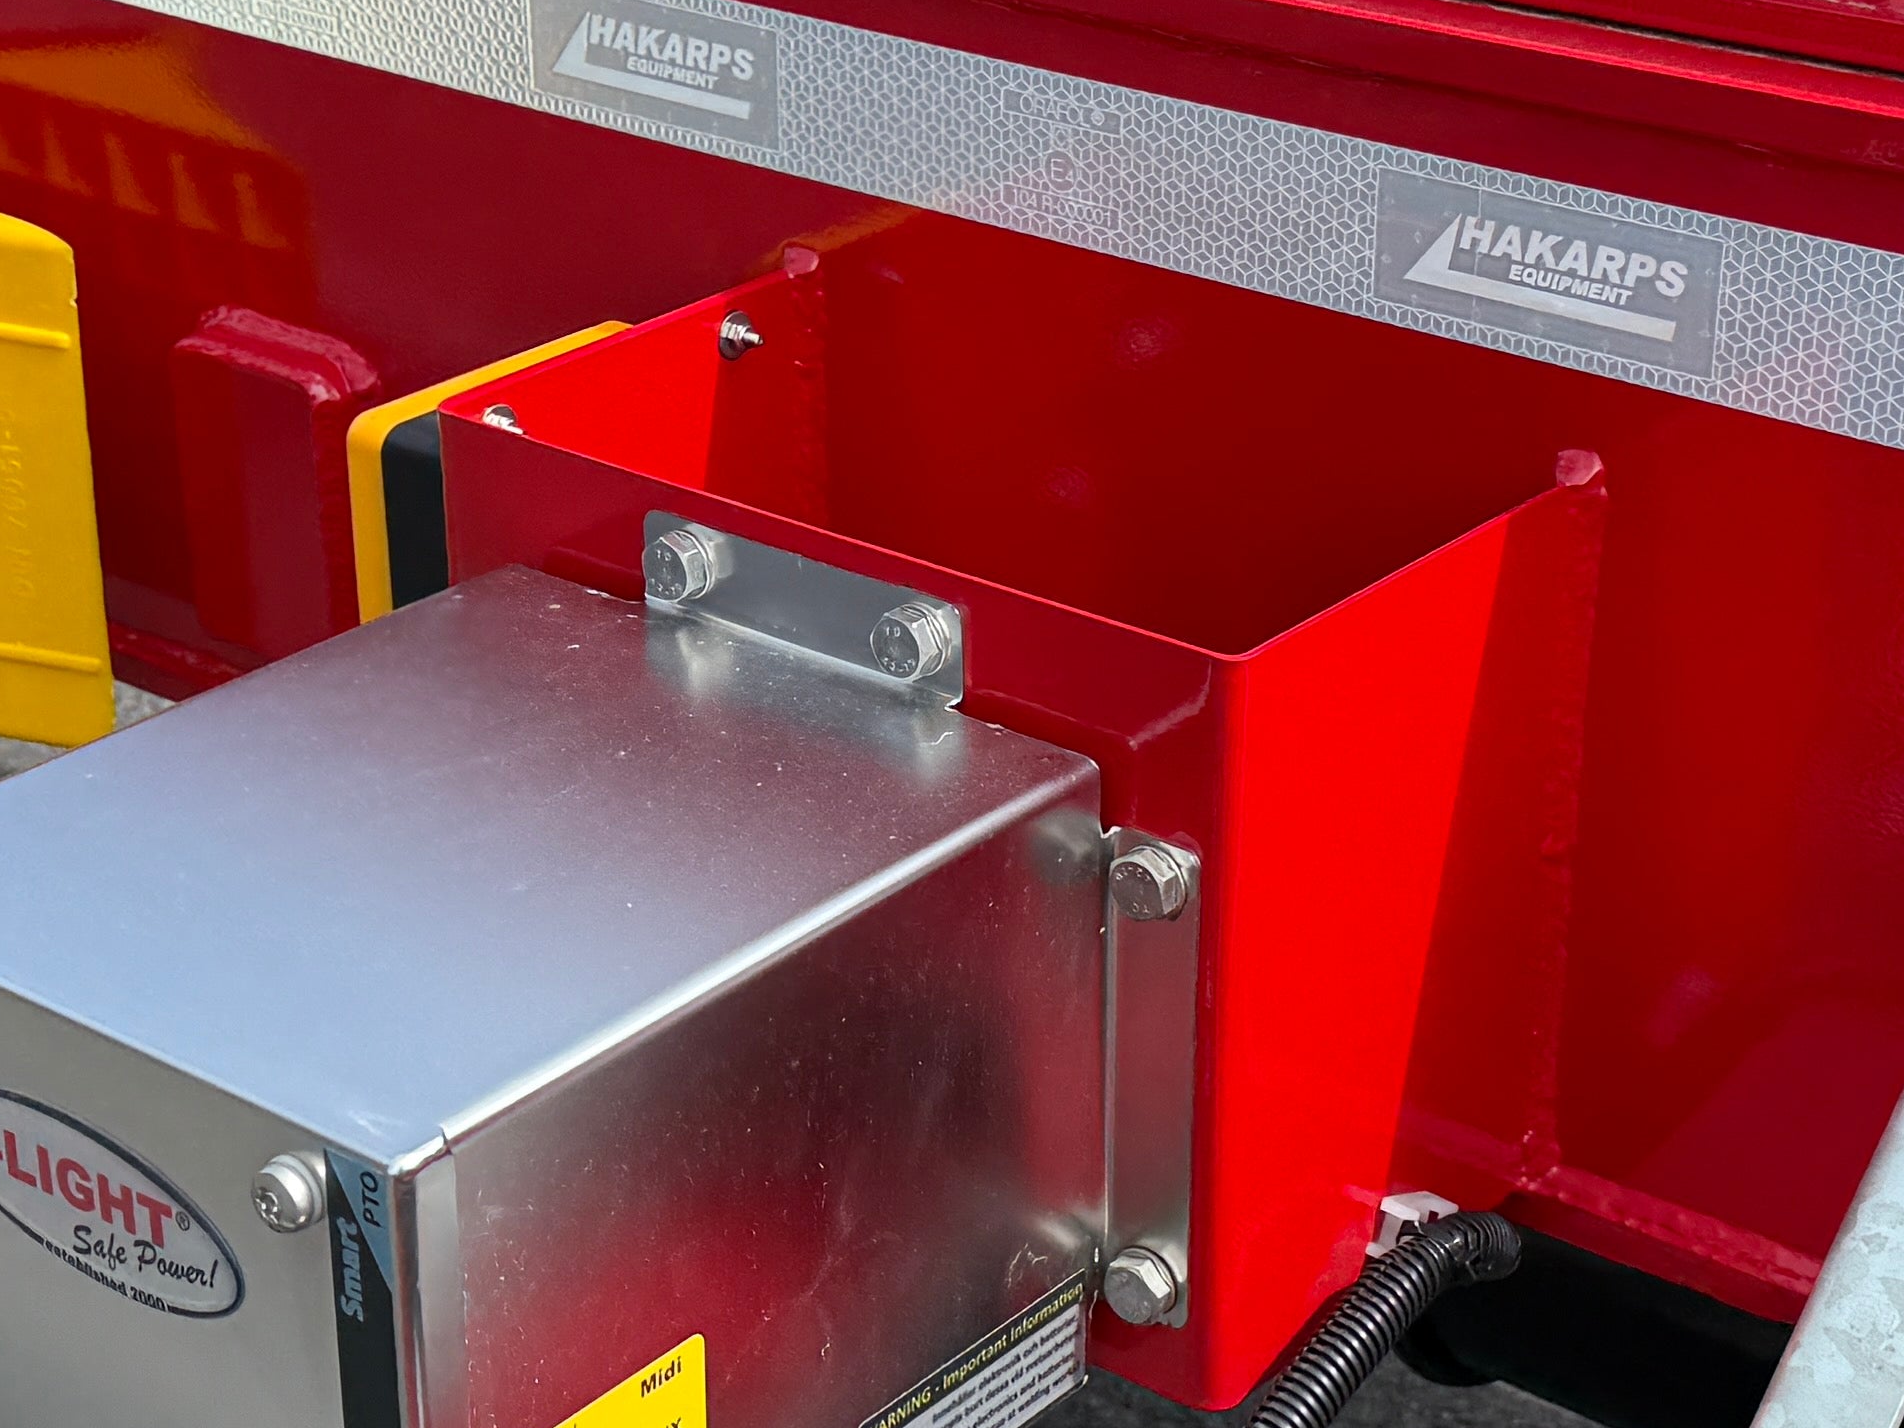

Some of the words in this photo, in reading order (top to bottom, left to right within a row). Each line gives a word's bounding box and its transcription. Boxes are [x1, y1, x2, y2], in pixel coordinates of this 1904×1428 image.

[588, 13, 755, 81] HAKARPS
[626, 55, 720, 90] EQUIPMENT
[1459, 216, 1689, 298] HAKARPS
[1507, 262, 1633, 306] EQUIPMENT
[45, 1240, 128, 1297] established
[73, 1224, 127, 1271] Safe
[133, 1239, 219, 1288] Power!
[336, 1216, 365, 1322] Smart
[359, 1171, 383, 1228] PTO
[942, 1334, 1007, 1391] Important
[1010, 1281, 1084, 1345] Information
[640, 1355, 683, 1398] Midi
